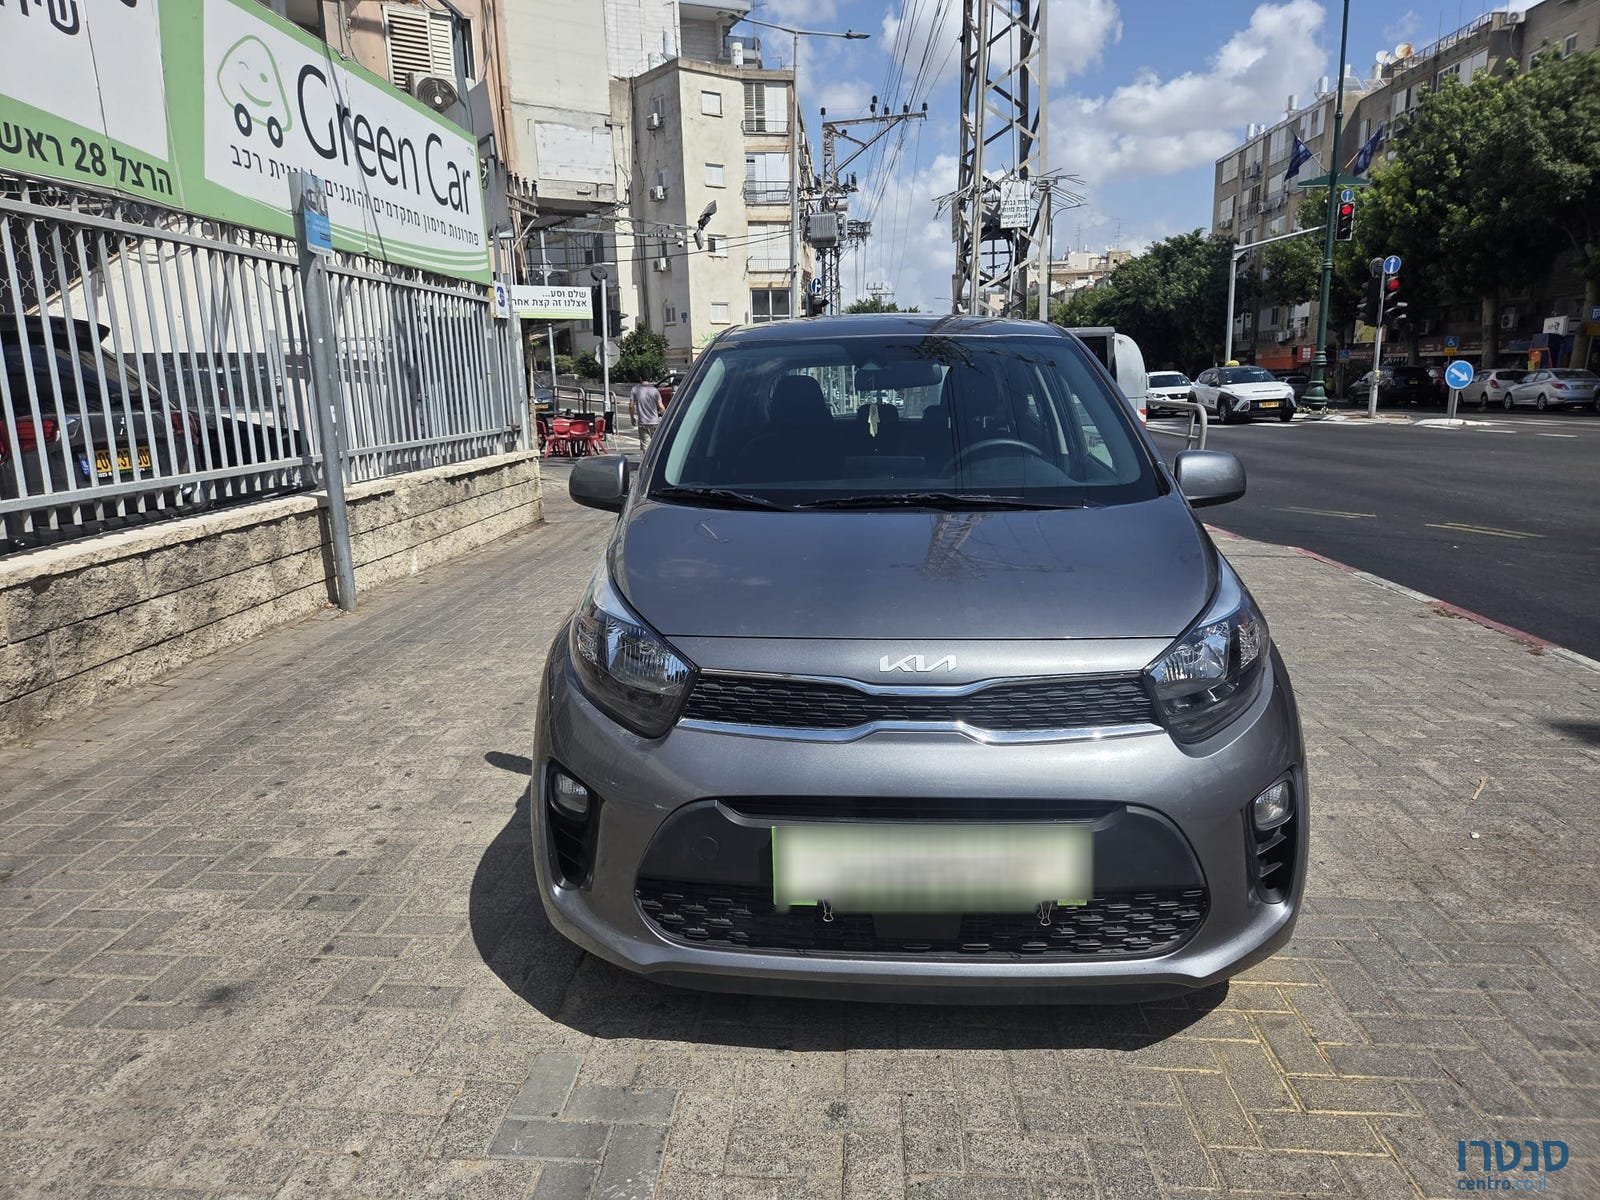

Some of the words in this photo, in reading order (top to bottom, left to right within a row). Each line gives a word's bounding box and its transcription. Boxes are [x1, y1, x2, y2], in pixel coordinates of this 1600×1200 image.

[297, 64, 420, 195] Green
[425, 133, 471, 215] Car
[71, 137, 107, 177] 28
[230, 144, 263, 173] רכב
[111, 146, 173, 195] הרצל
[324, 179, 370, 209] והוגנים
[374, 197, 420, 226] מתקדמים
[423, 214, 446, 235] מימון
[449, 224, 479, 246] פתרונות
[532, 299, 550, 308] קצת
[552, 299, 561, 307] זה
[564, 299, 587, 307] אצלנו
[568, 290, 586, 298] שלם
[879, 654, 957, 673] KIA
